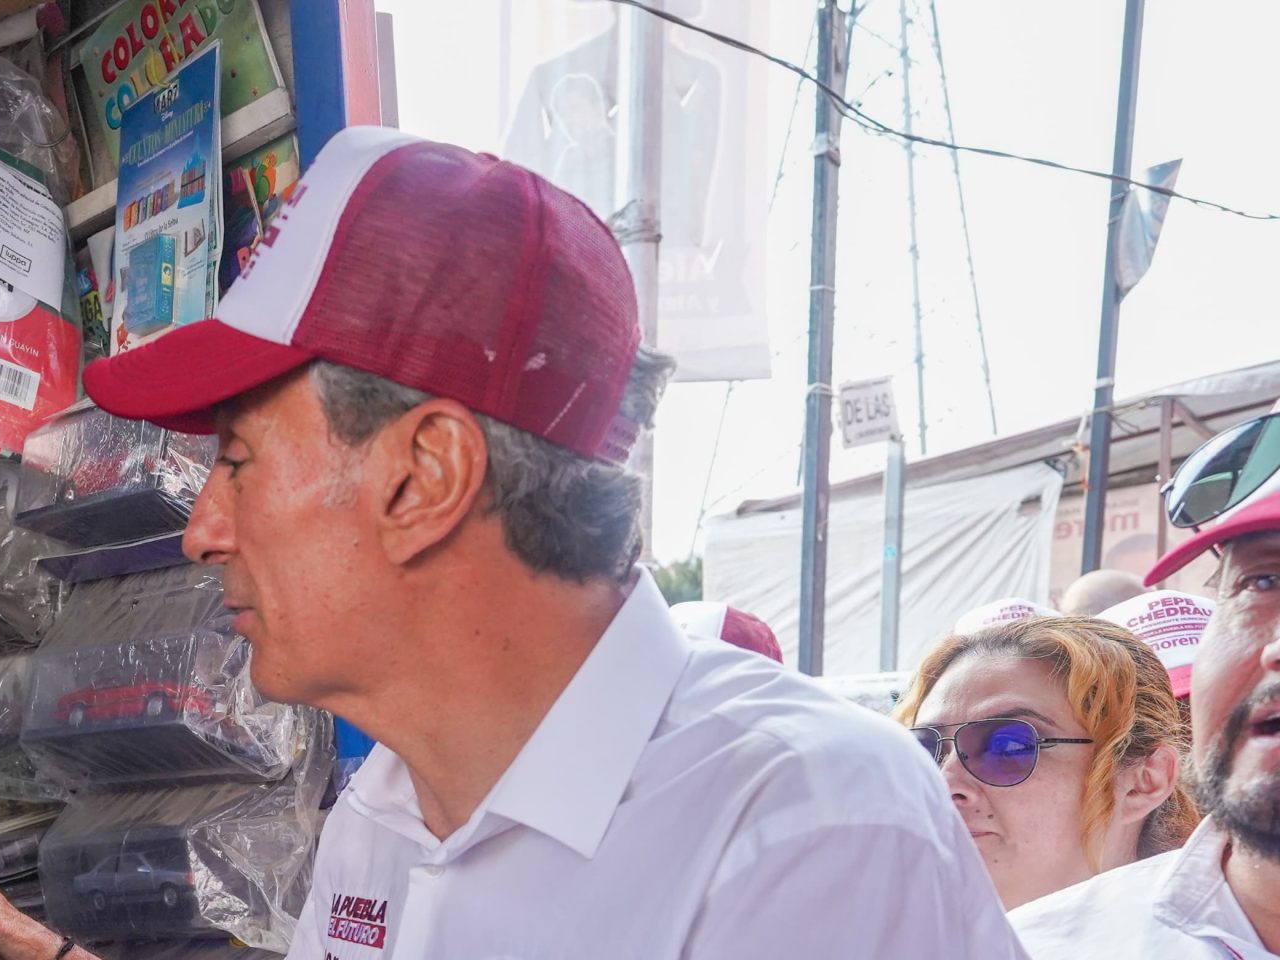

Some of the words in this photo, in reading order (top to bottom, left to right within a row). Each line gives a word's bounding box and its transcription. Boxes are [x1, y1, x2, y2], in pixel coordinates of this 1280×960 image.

[5, 249, 27, 267] luppa
[844, 398, 864, 426] DE
[865, 392, 891, 421] LAS
[1147, 596, 1196, 610] PEPE
[1126, 606, 1214, 628] CHEDRAU
[338, 895, 388, 924] PUEBLA
[337, 919, 380, 945] FUTURO
